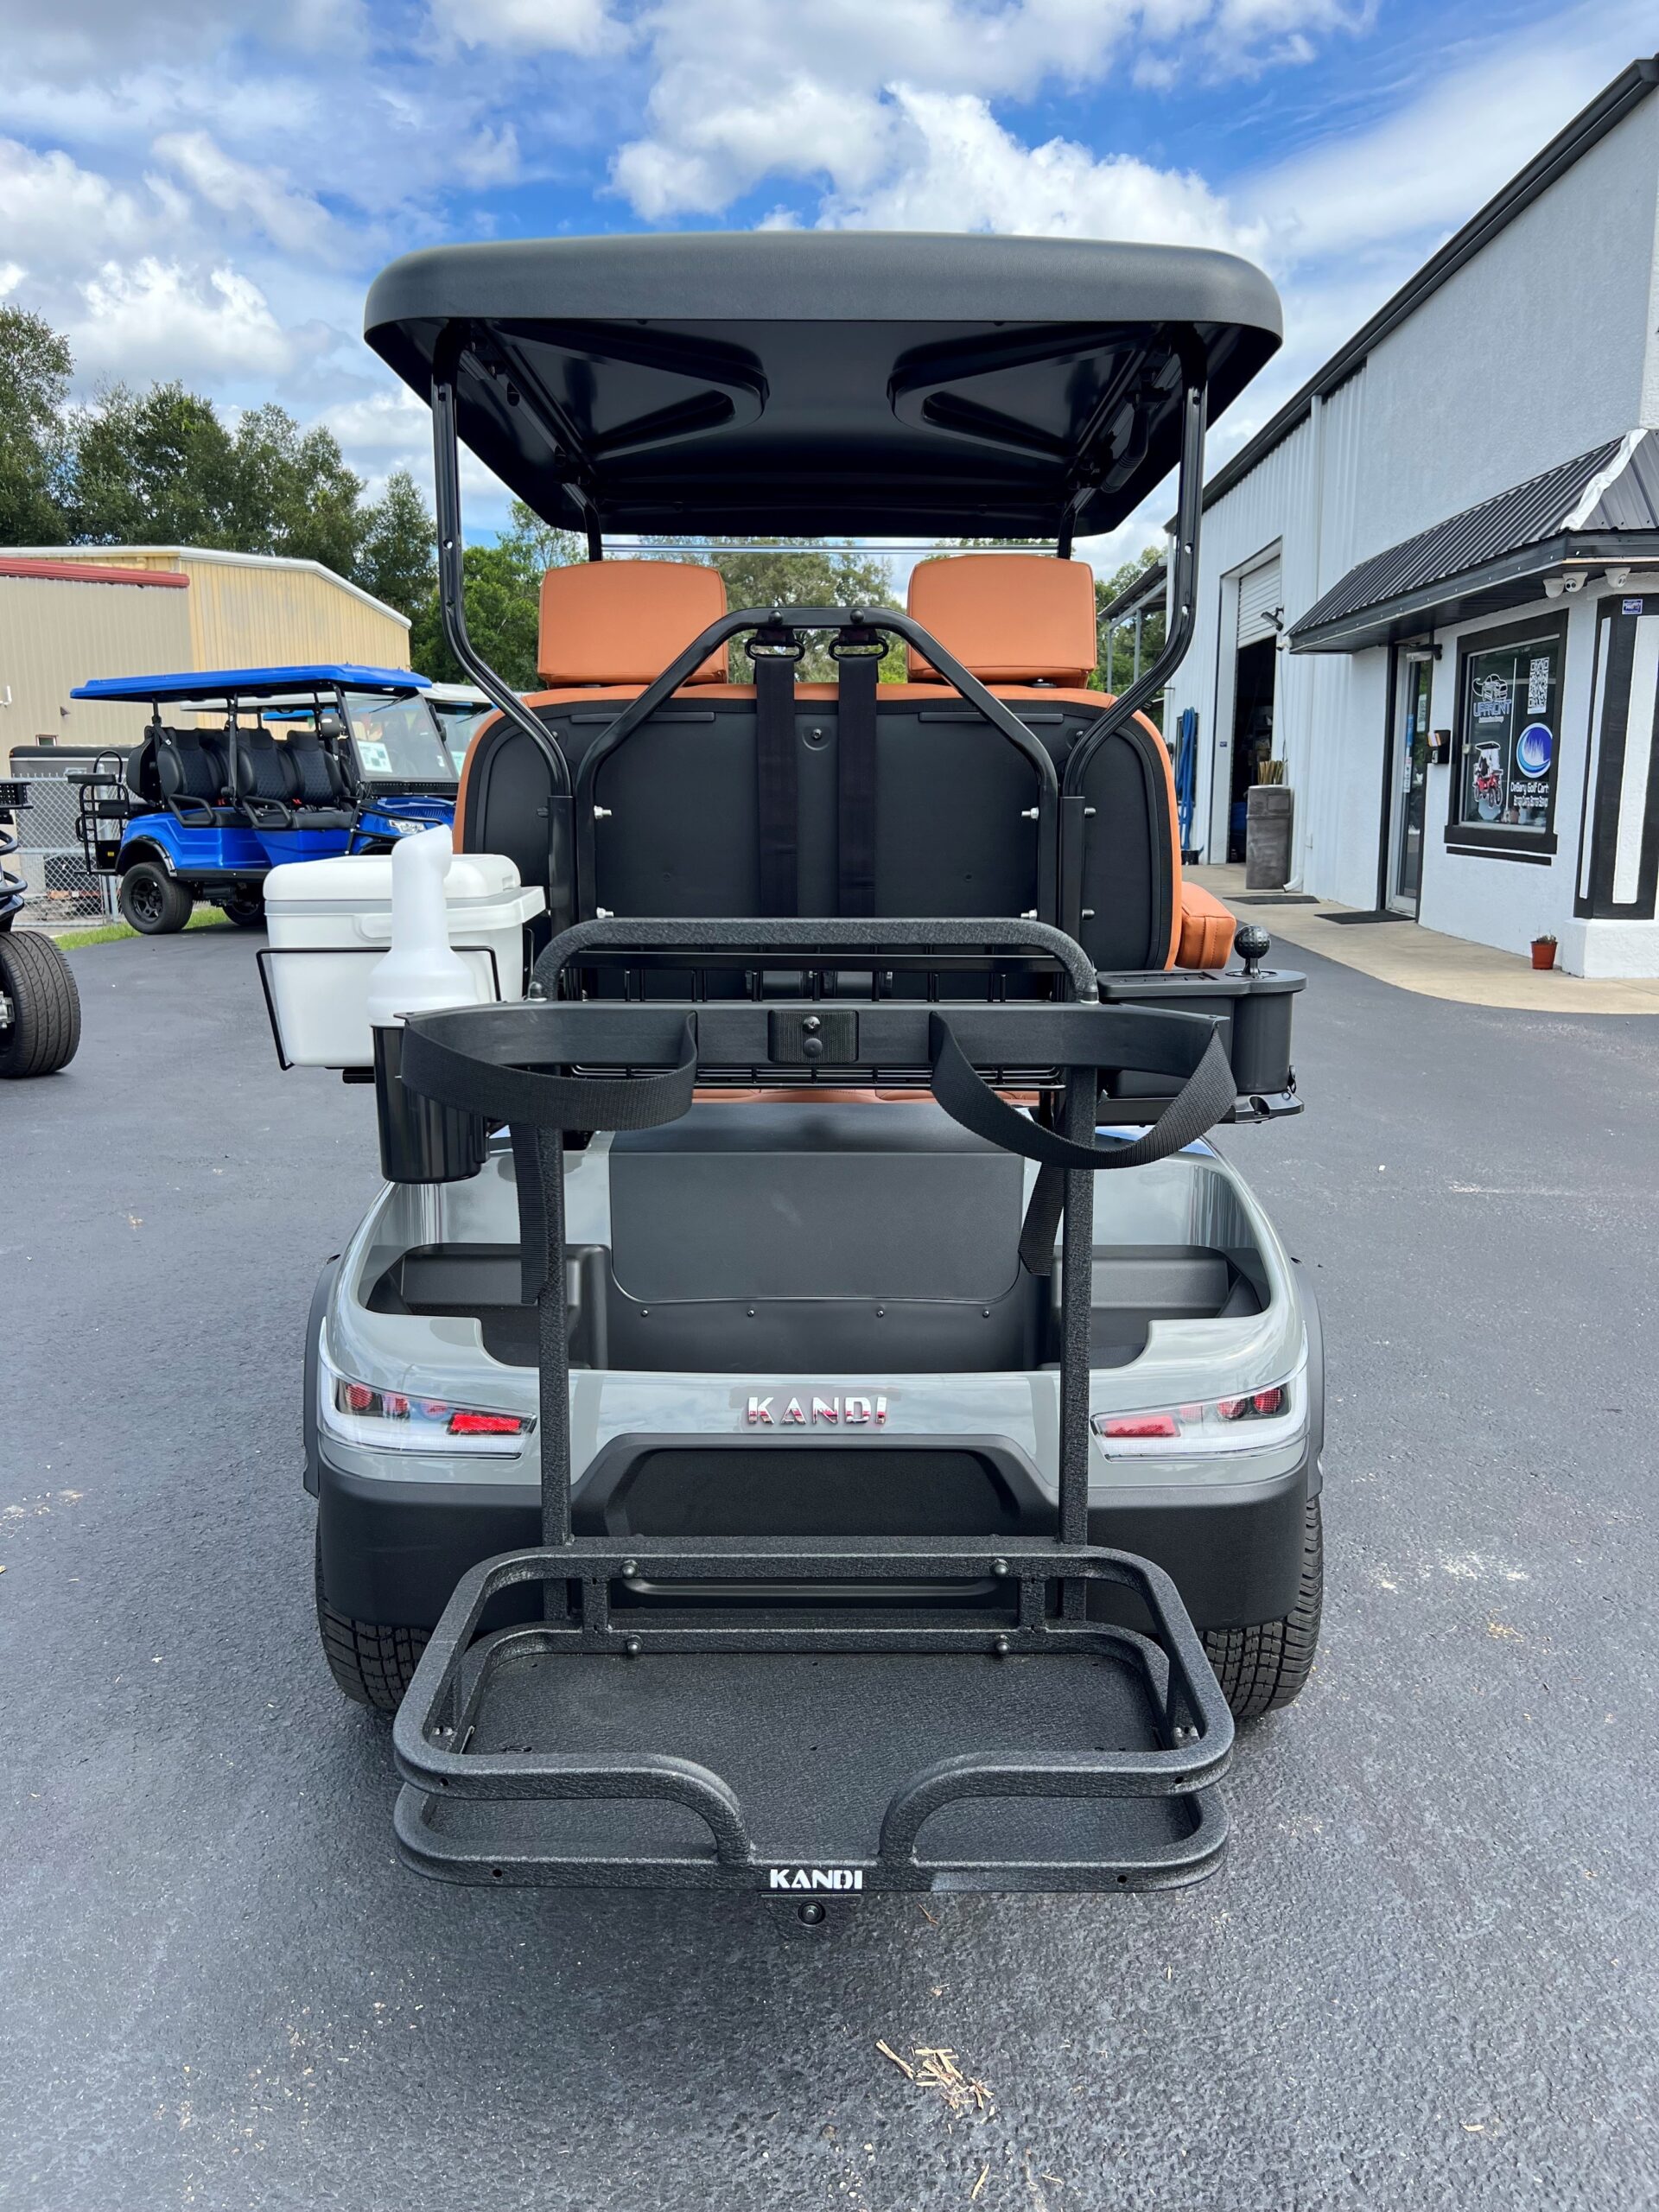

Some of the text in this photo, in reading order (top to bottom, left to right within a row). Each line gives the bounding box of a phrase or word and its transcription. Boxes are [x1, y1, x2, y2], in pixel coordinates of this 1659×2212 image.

[1527, 782, 1538, 793] Golf
[1537, 783, 1549, 793] Cart
[747, 1396, 888, 1425] KANDI
[769, 1869, 863, 1890] KANDI
